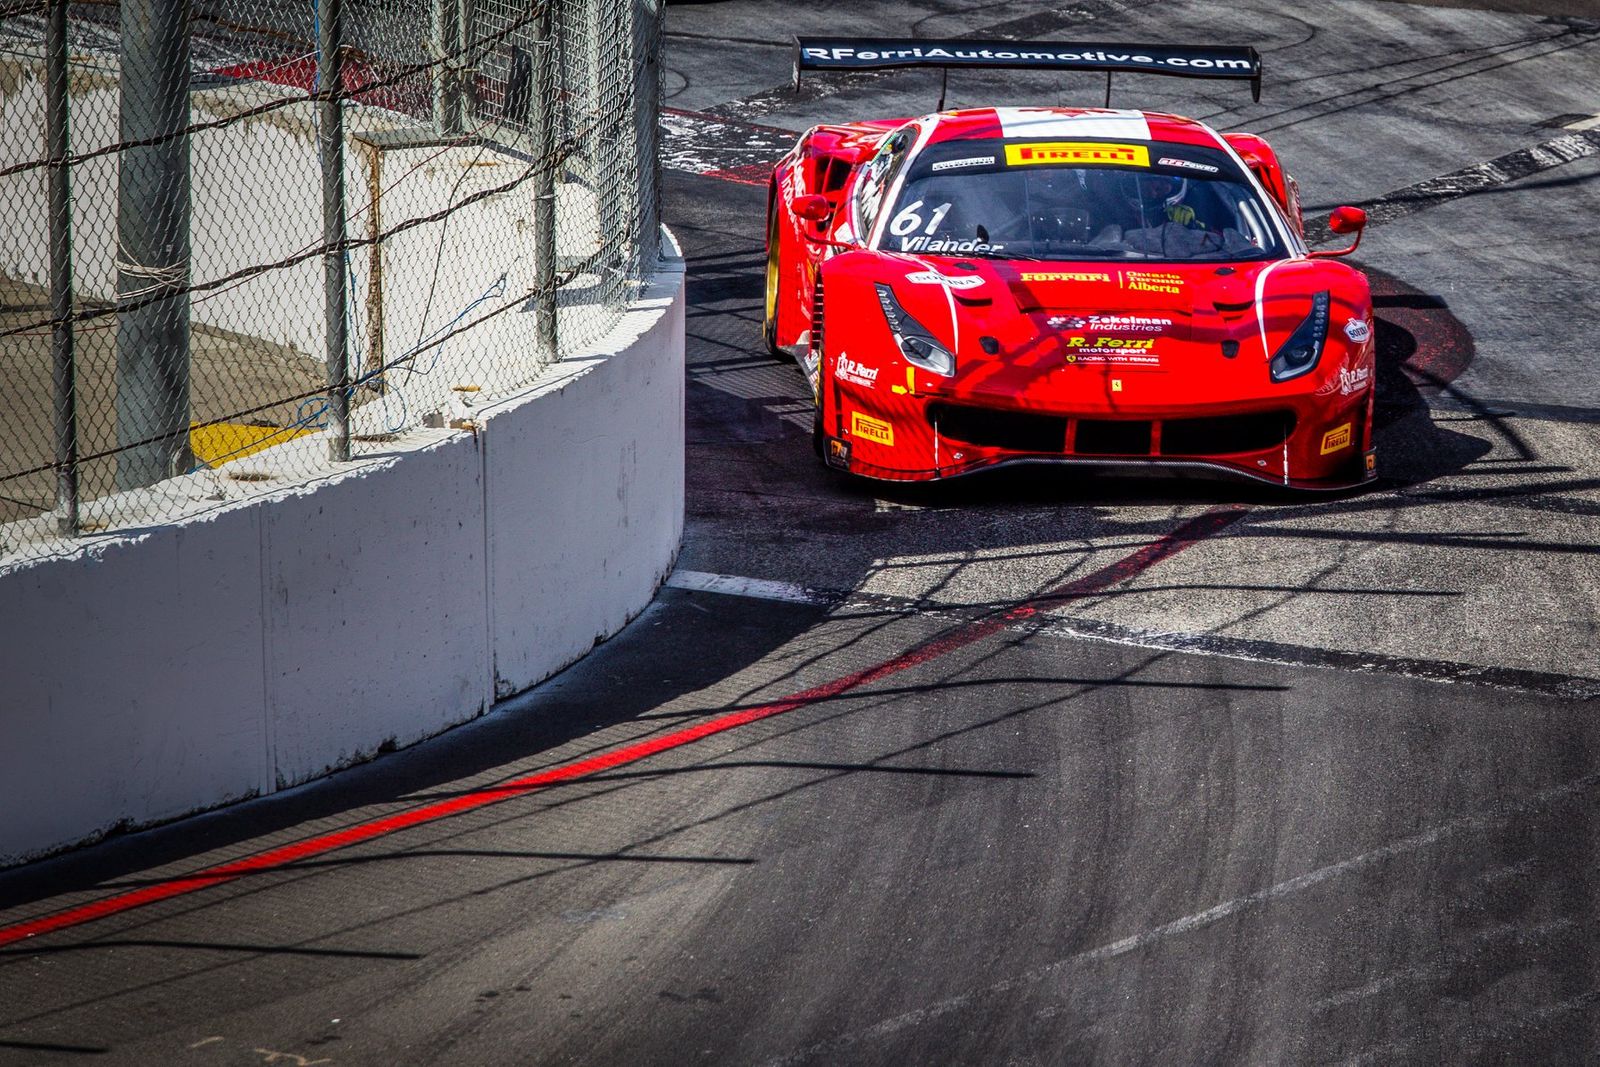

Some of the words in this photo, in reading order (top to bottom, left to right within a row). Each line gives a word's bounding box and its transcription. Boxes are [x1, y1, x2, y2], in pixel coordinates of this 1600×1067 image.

[803, 47, 1251, 69] RFerriAutomotive.com
[1020, 147, 1136, 161] PIRELLI
[889, 200, 952, 236] 61
[901, 236, 1004, 253] Vilander
[1020, 272, 1111, 282] Ferrari
[1126, 271, 1181, 280] Ontario
[1127, 276, 1184, 285] Toronto
[1128, 281, 1180, 294] Alberta
[1088, 315, 1172, 326] Zekelman
[1090, 322, 1163, 332] Industries
[1094, 337, 1155, 349] Ferri
[1079, 347, 1147, 355] motorsport
[856, 417, 889, 441] PIRELLI
[1323, 428, 1349, 450] PIRELLI
